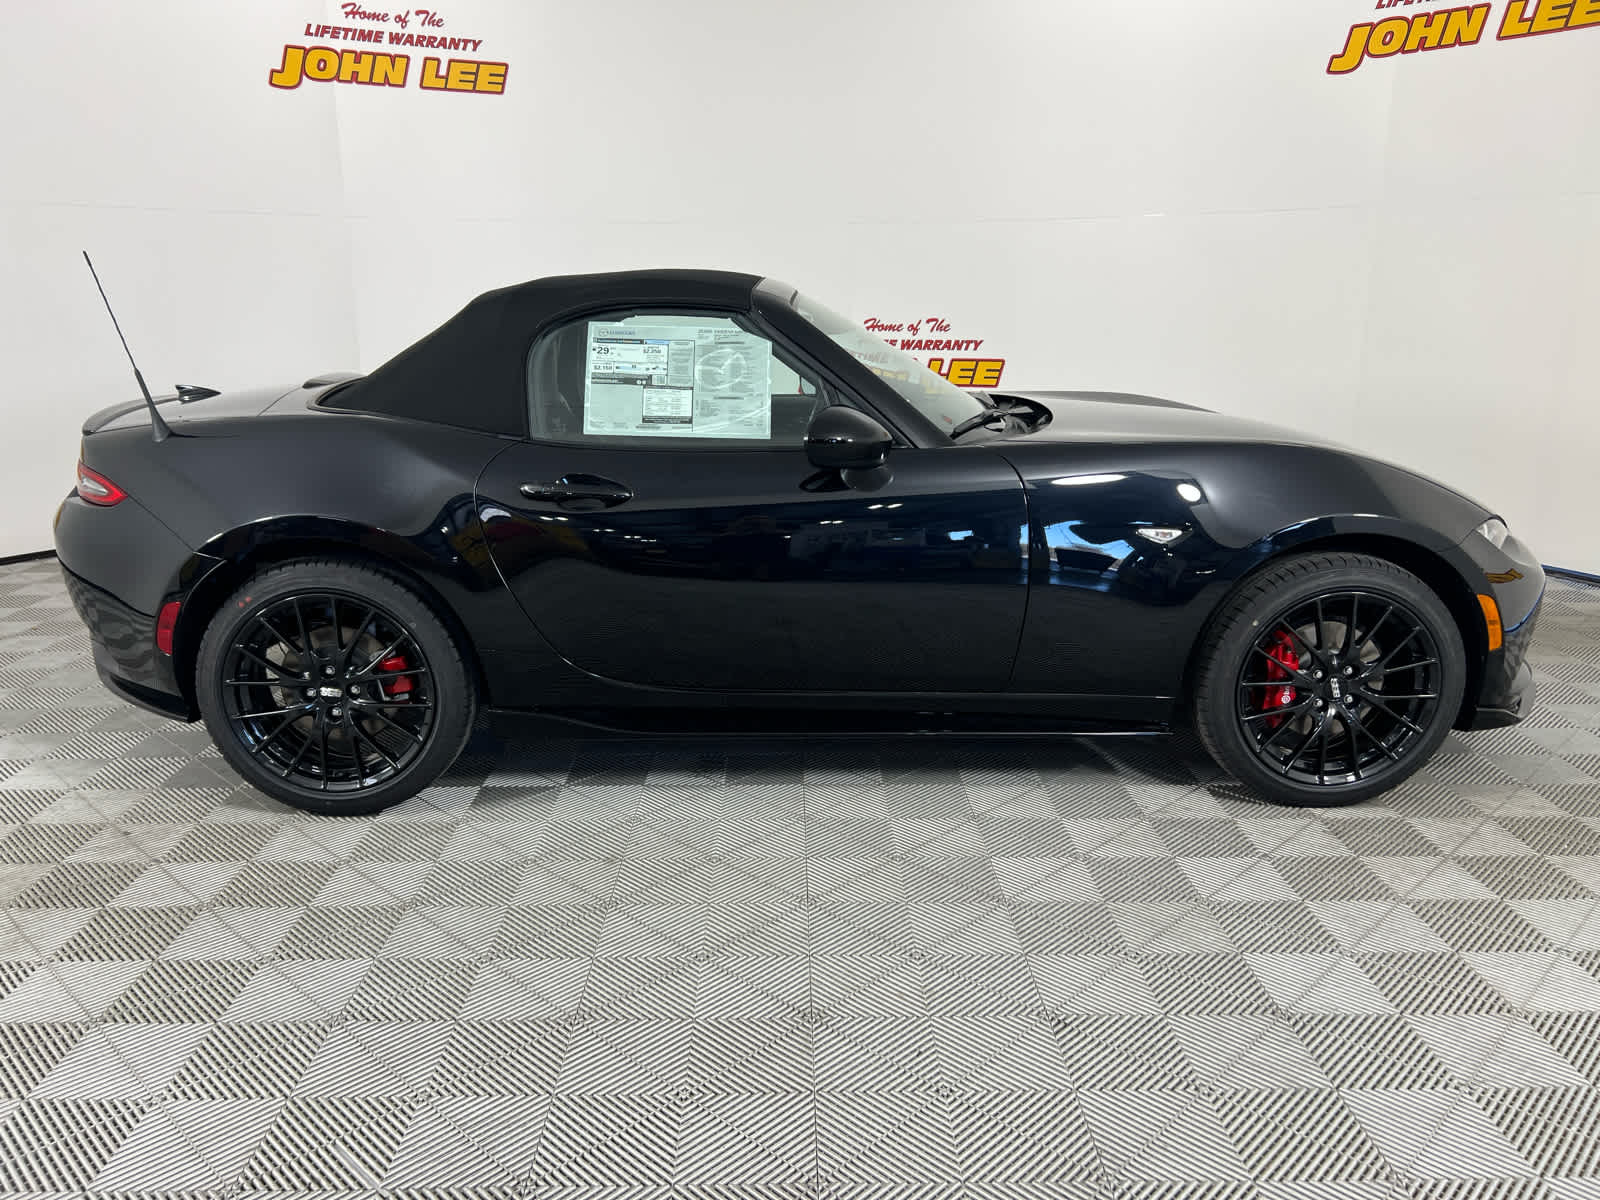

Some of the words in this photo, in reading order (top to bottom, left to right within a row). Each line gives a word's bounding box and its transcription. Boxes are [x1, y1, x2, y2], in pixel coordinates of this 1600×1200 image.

[341, 2, 390, 23] Home
[394, 12, 409, 29] of
[415, 9, 445, 28] The
[304, 23, 385, 44] LIFETIME
[388, 31, 482, 52] WARRANTY
[1326, 2, 1492, 75] JOHN
[269, 44, 411, 90] JOHN
[420, 56, 510, 95] LEE
[863, 318, 904, 333] Home
[908, 319, 922, 337] of
[926, 318, 952, 333] The
[596, 346, 610, 355] 29
[900, 339, 984, 351] WARRANTY
